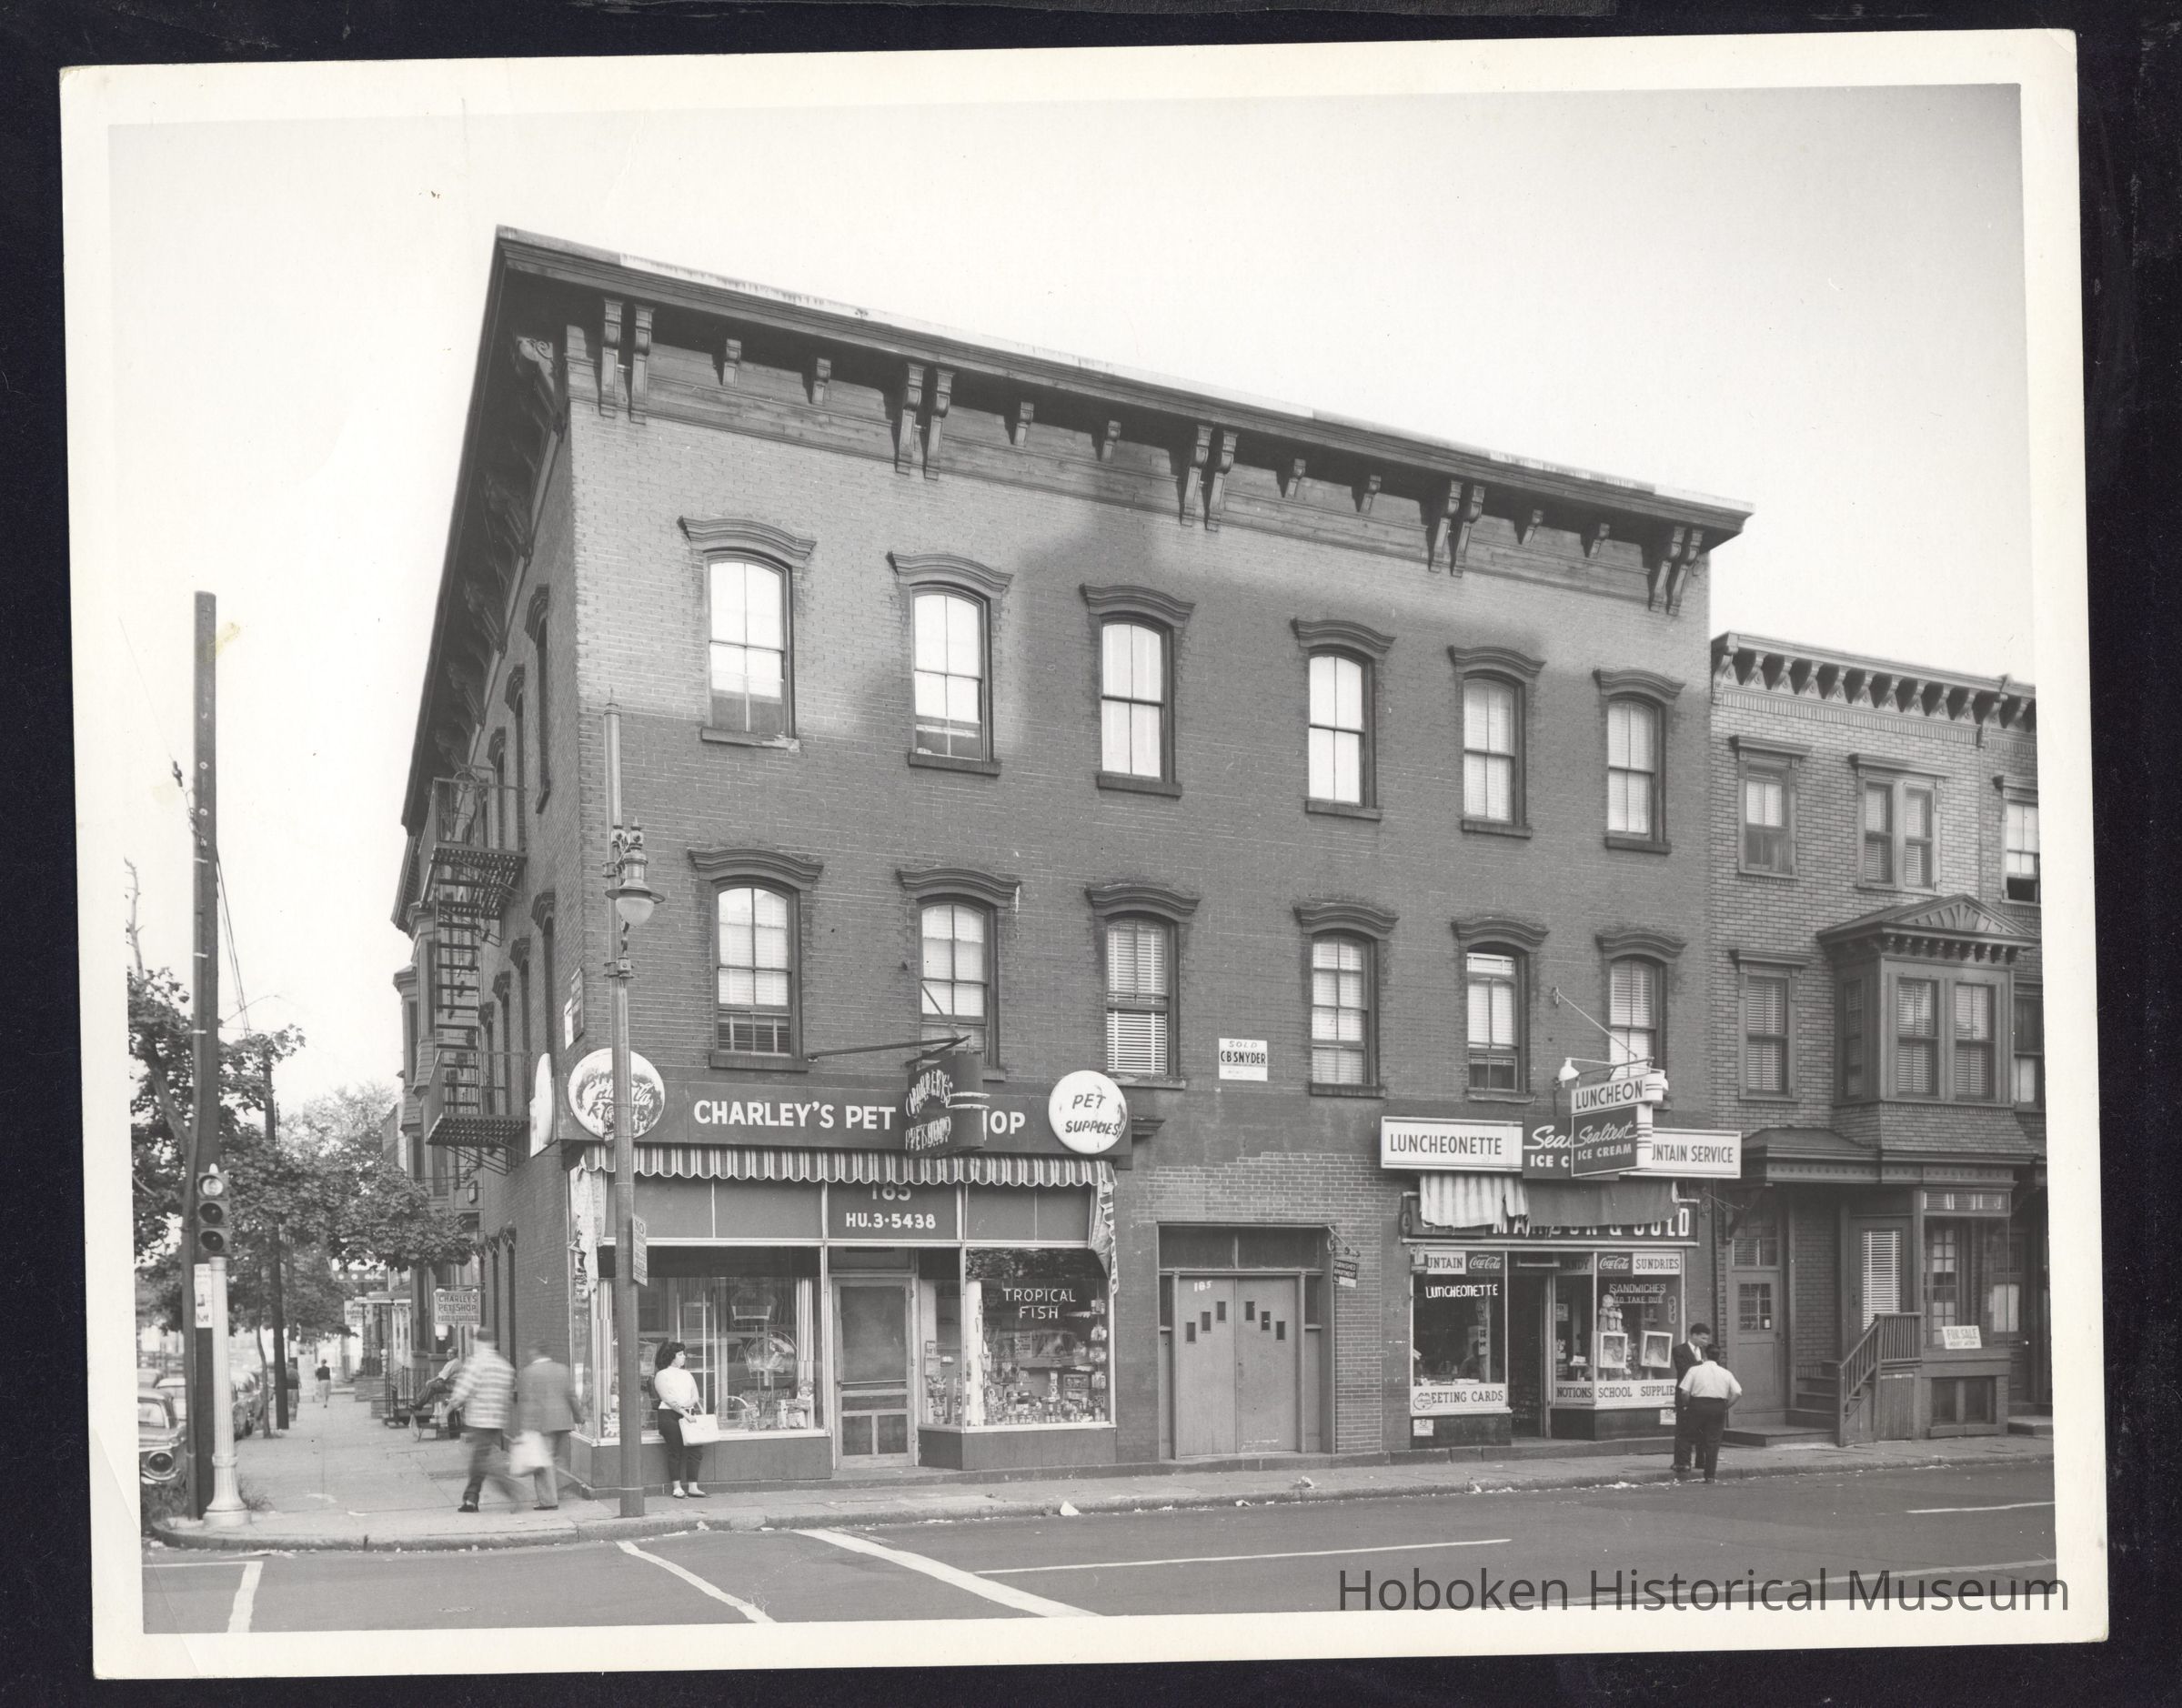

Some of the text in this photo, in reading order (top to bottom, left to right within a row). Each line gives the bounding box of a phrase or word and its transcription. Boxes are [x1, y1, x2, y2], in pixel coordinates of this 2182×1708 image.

[1229, 1040, 1258, 1049] SOLD
[1072, 1093, 1106, 1110] PET
[1575, 1080, 1644, 1110] LUNCHEON
[693, 1099, 835, 1130] CHARLEY'S
[845, 1104, 897, 1130] PET
[1064, 1120, 1121, 1136] SUPPLIES
[1574, 1120, 1635, 1147] Sealtest
[1390, 1133, 1503, 1155] LUNCHEONETTE
[1578, 1149, 1593, 1161] ICE
[1596, 1143, 1632, 1158] CREAM
[1692, 1144, 1735, 1164] SERVICE
[1530, 1154, 1554, 1168] ICE
[1469, 1255, 1502, 1270] Coca-Cola
[1560, 1258, 1590, 1271] ANDY
[1599, 1256, 1630, 1270] Coca-Cola
[1635, 1258, 1680, 1270] SUNDRIES
[1425, 1283, 1499, 1299] LUNCHEONETTE
[1609, 1282, 1666, 1293] SANDWICHES
[1002, 1289, 1077, 1302] TROPICAL
[438, 1302, 478, 1311] PET SHOP
[1019, 1306, 1059, 1319] FISH
[1471, 1390, 1503, 1402] CARDS
[1556, 1386, 1593, 1399] NOTIONS
[1598, 1384, 1675, 1399] SCHOOL SUPPLIE
